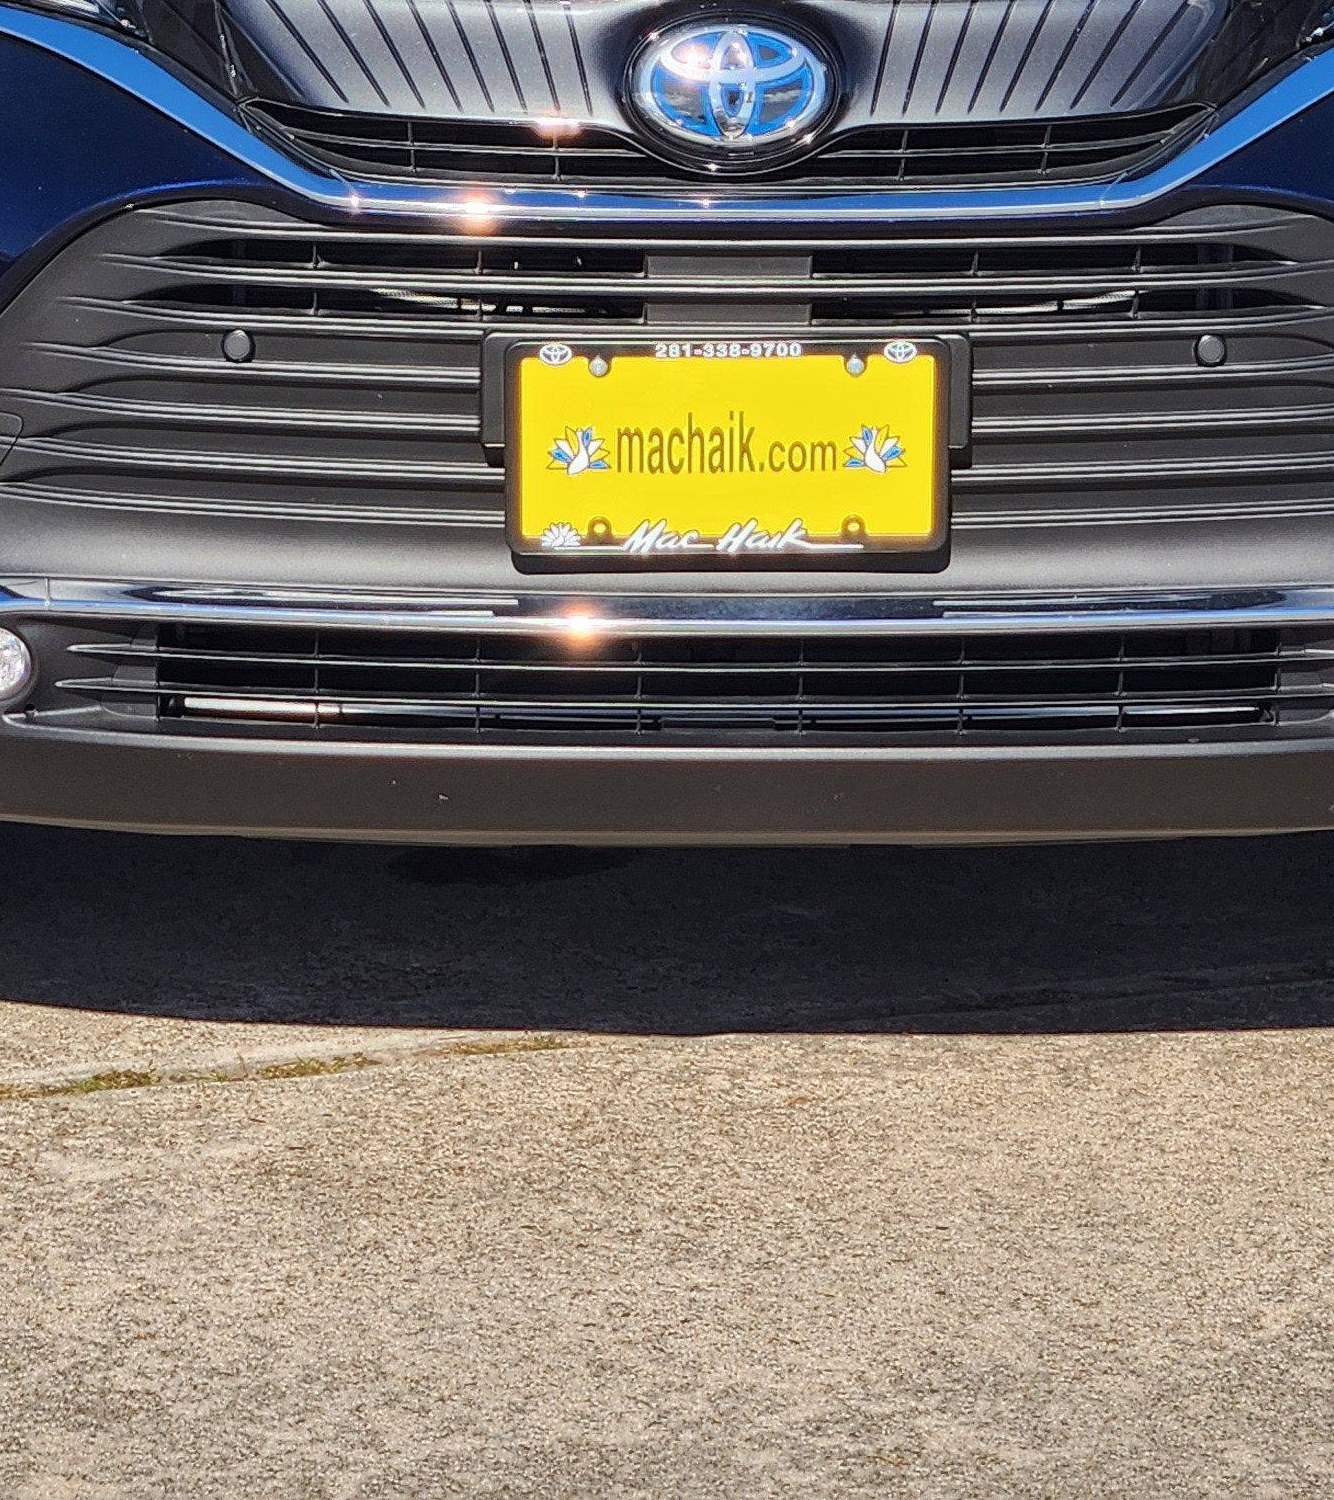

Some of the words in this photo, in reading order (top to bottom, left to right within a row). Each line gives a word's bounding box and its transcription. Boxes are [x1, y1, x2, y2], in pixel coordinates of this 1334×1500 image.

[655, 342, 802, 358] 281-338-9700
[616, 410, 837, 475] machaik.com
[622, 518, 713, 555] Mac
[717, 517, 817, 555] Haik
